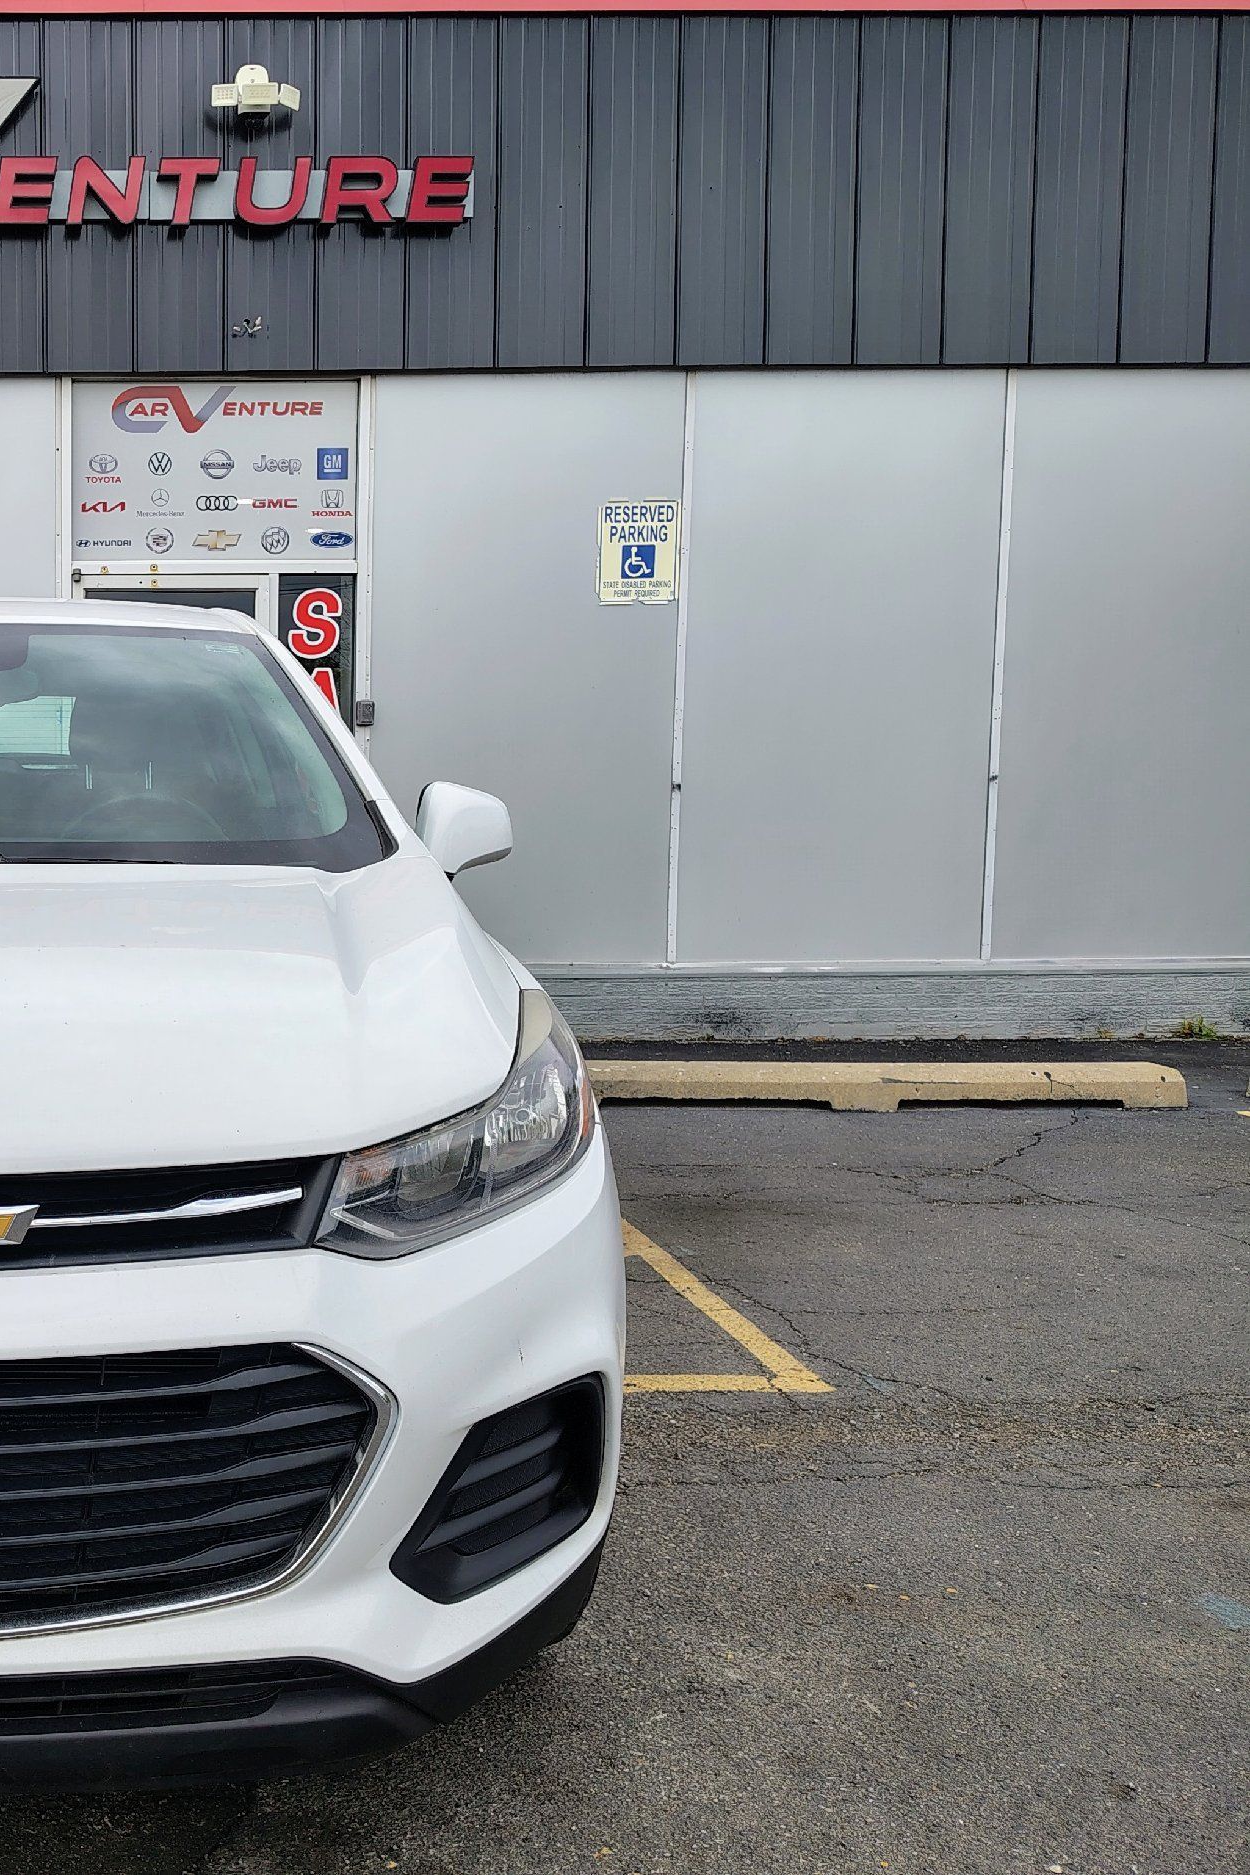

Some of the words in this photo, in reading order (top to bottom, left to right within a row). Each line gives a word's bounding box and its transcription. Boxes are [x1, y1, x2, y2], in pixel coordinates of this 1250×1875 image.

[252, 454, 303, 475] Jeep
[323, 454, 342, 470] GM
[85, 476, 122, 484] TOYOTA
[81, 501, 126, 513] KIA
[252, 498, 298, 509] GMC
[604, 505, 675, 523] RESERVED
[318, 533, 345, 545] Ford
[609, 525, 668, 543] PARKING
[92, 539, 132, 547] HYUNDAI
[602, 581, 619, 589] STATE
[648, 580, 672, 588] PARKING
[634, 589, 660, 597] REQUIRED
